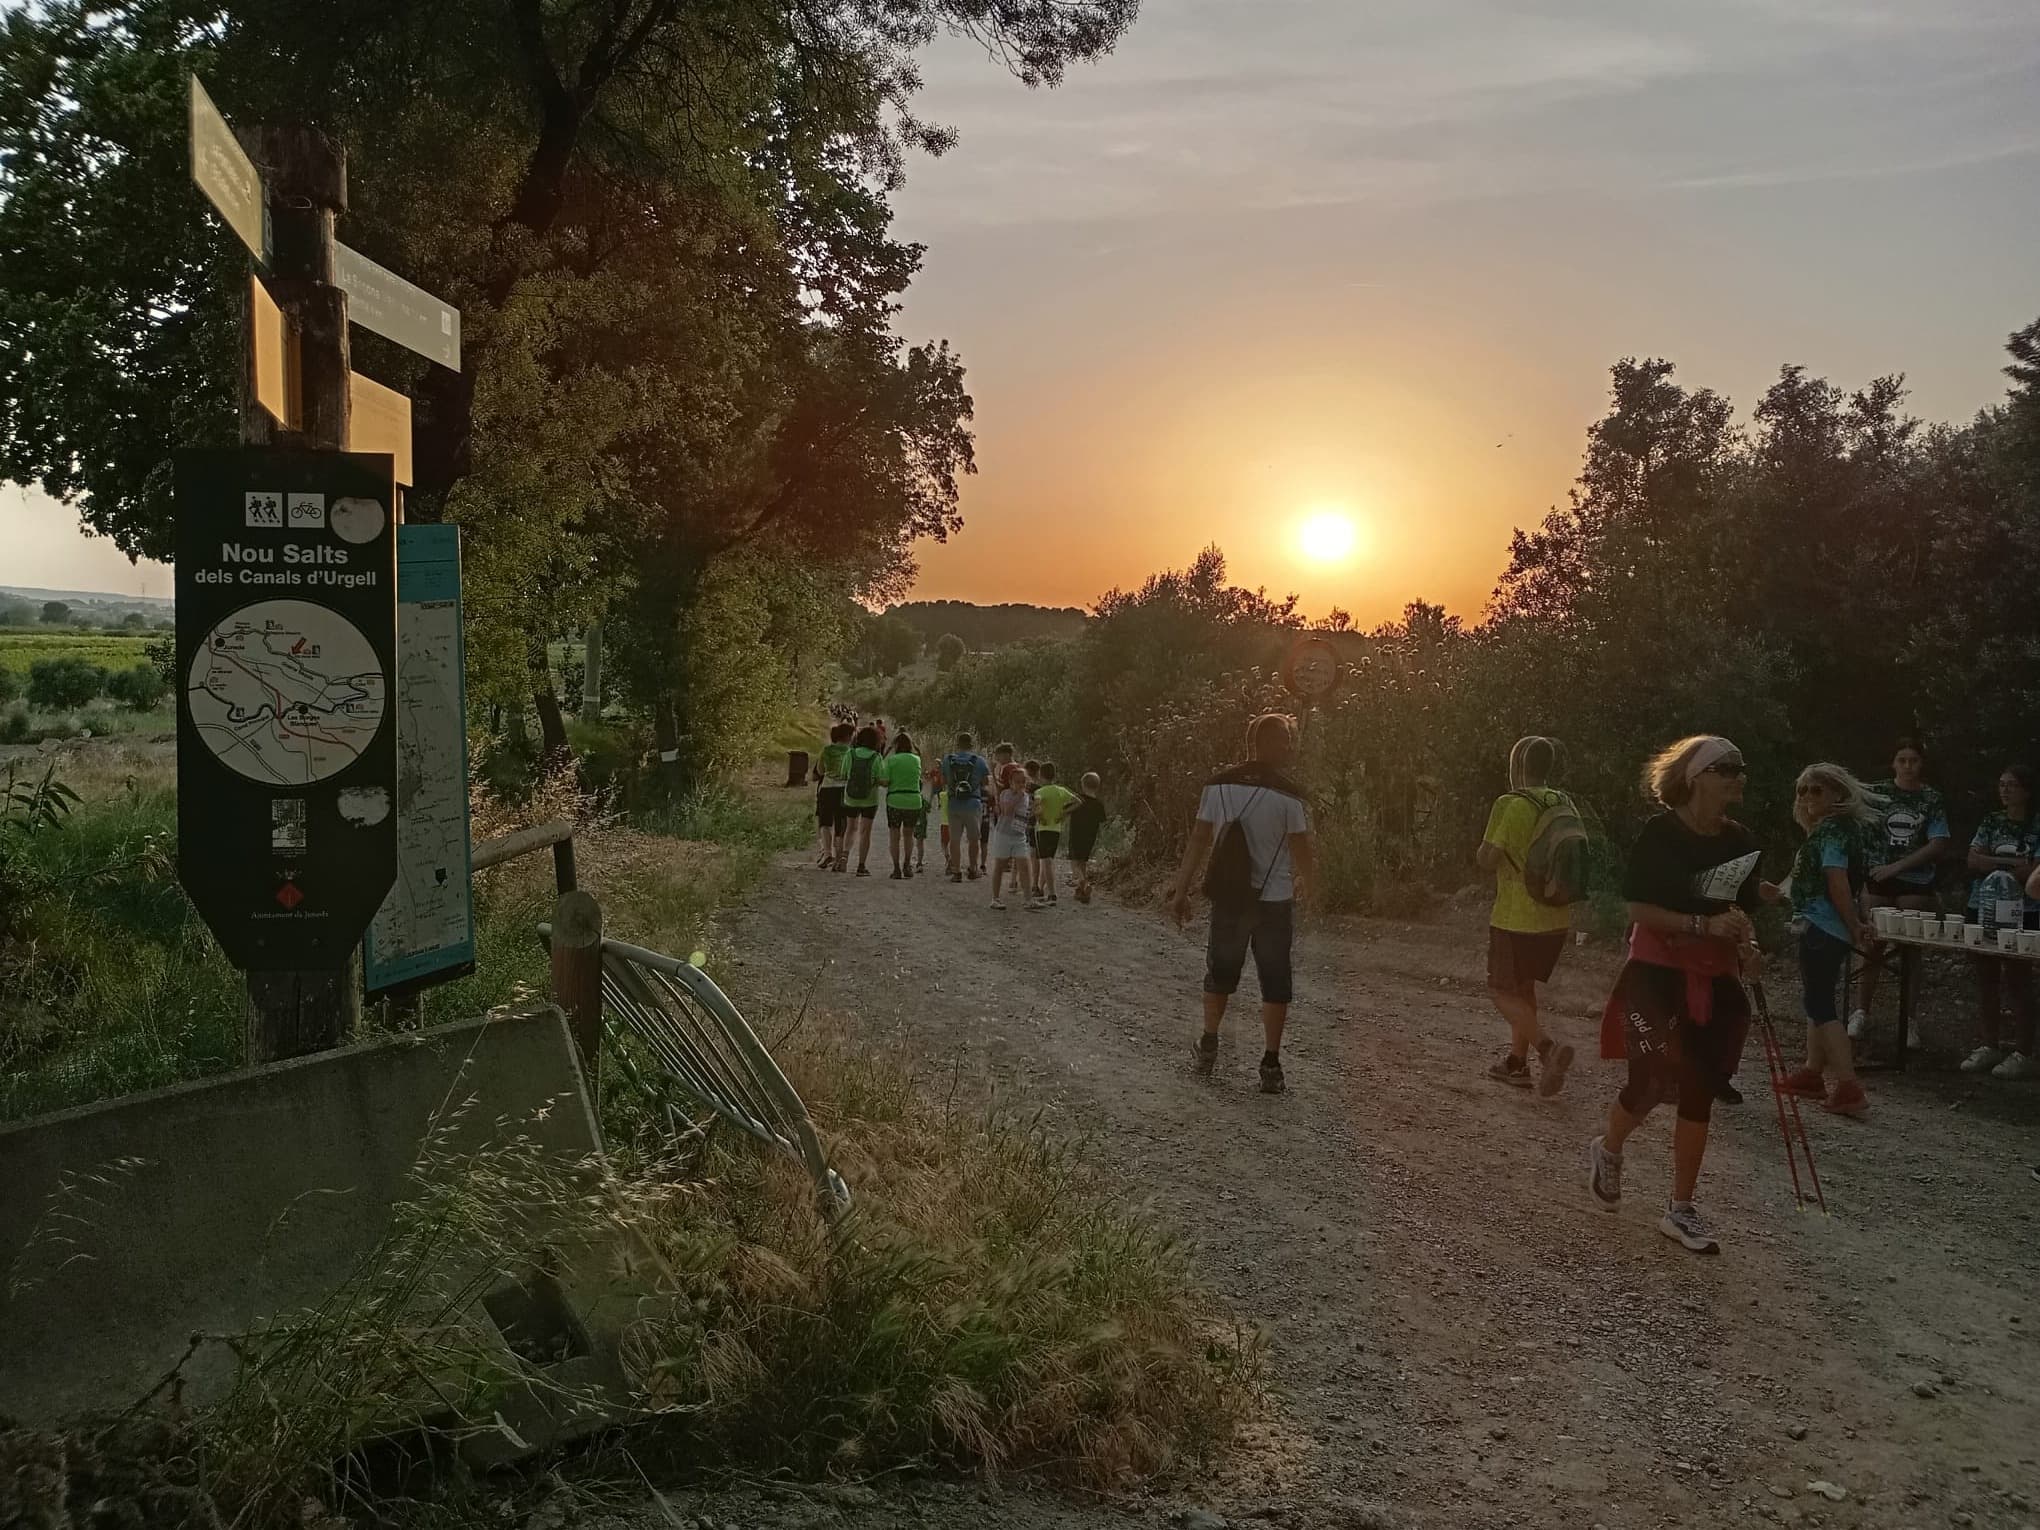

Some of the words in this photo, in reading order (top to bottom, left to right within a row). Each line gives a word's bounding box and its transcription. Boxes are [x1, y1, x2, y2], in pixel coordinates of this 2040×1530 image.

[222, 543, 274, 563] Nou
[283, 544, 349, 564] Salts
[195, 569, 233, 584] dels
[239, 569, 302, 585] Canals
[307, 570, 377, 588] d'Urgell
[1630, 1012, 1653, 1033] PRO
